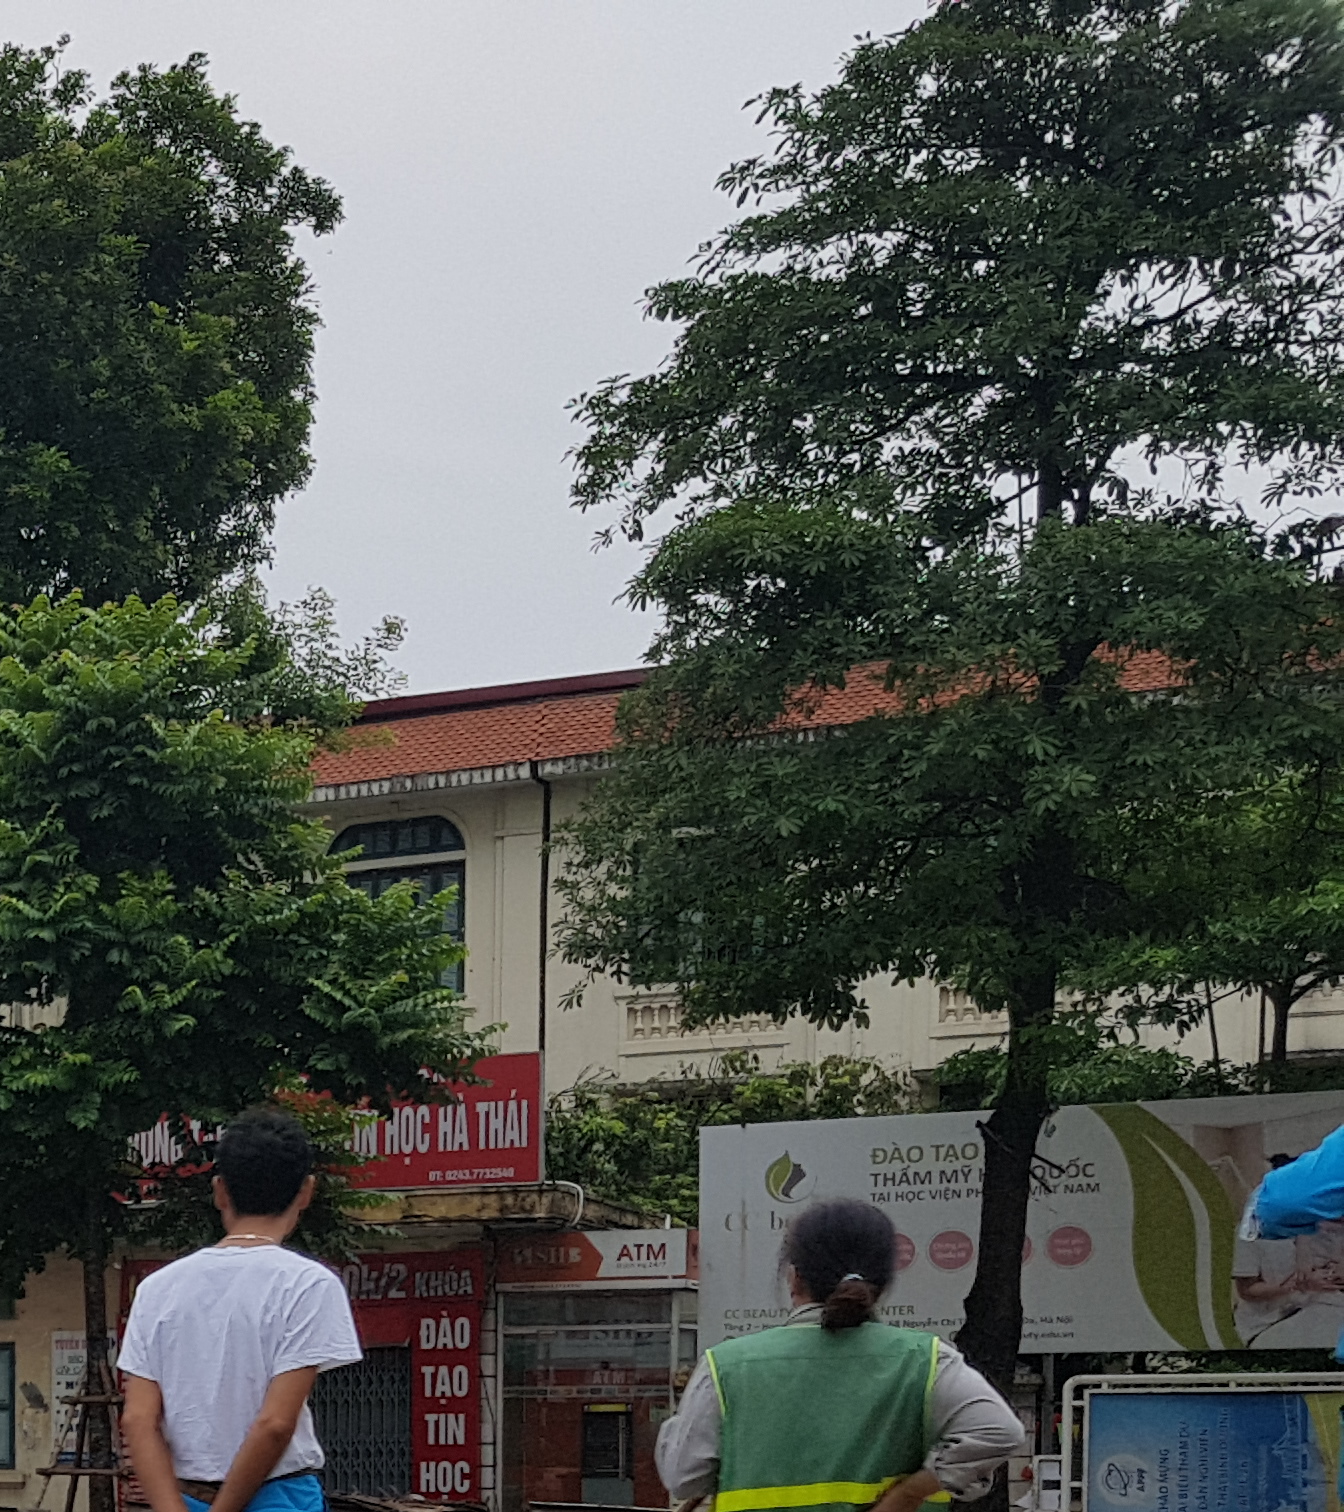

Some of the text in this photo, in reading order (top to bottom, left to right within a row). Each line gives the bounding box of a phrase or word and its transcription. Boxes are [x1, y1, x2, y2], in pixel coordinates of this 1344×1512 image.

[385, 1104, 431, 1166] HỌC
[438, 1092, 470, 1153] HÀ
[475, 1088, 529, 1150] THÁI
[869, 1142, 980, 1166] ĐÀO TẠO
[939, 1164, 972, 1185] MỸ
[1029, 1157, 1096, 1182] QUỐC
[895, 1189, 926, 1204] HỌC
[931, 1187, 962, 1202] VIỆN
[967, 1188, 984, 1199] PH
[1064, 1182, 1101, 1195] NAM
[616, 1242, 667, 1262] ATM
[414, 1264, 474, 1298] KHÓA
[724, 1309, 738, 1319] CC
[880, 1305, 915, 1316] NTER
[419, 1310, 471, 1350] ĐÀO
[421, 1364, 469, 1405] TẠO
[424, 1413, 465, 1446] TIN
[419, 1460, 471, 1500] HỌC
